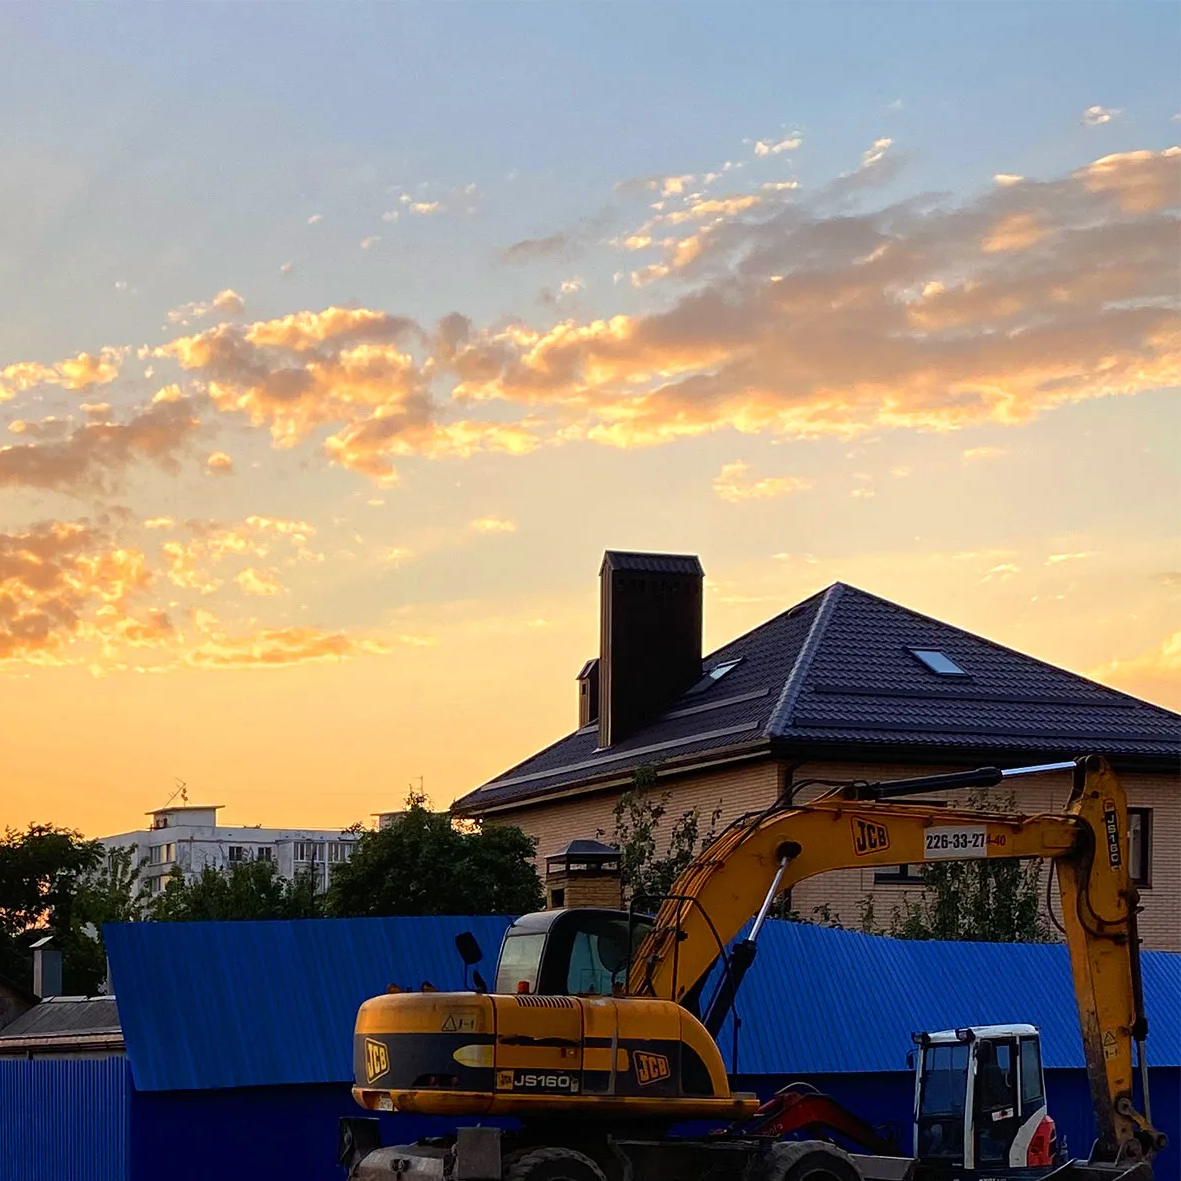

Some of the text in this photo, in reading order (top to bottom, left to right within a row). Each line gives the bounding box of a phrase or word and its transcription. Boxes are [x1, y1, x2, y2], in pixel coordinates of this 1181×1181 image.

[856, 820, 887, 852] JCB
[926, 833, 985, 850] 226-33-27
[1106, 814, 1119, 862] JS160
[367, 1043, 387, 1079] JCB
[638, 1054, 668, 1082] JCB
[514, 1075, 570, 1088] JS160
